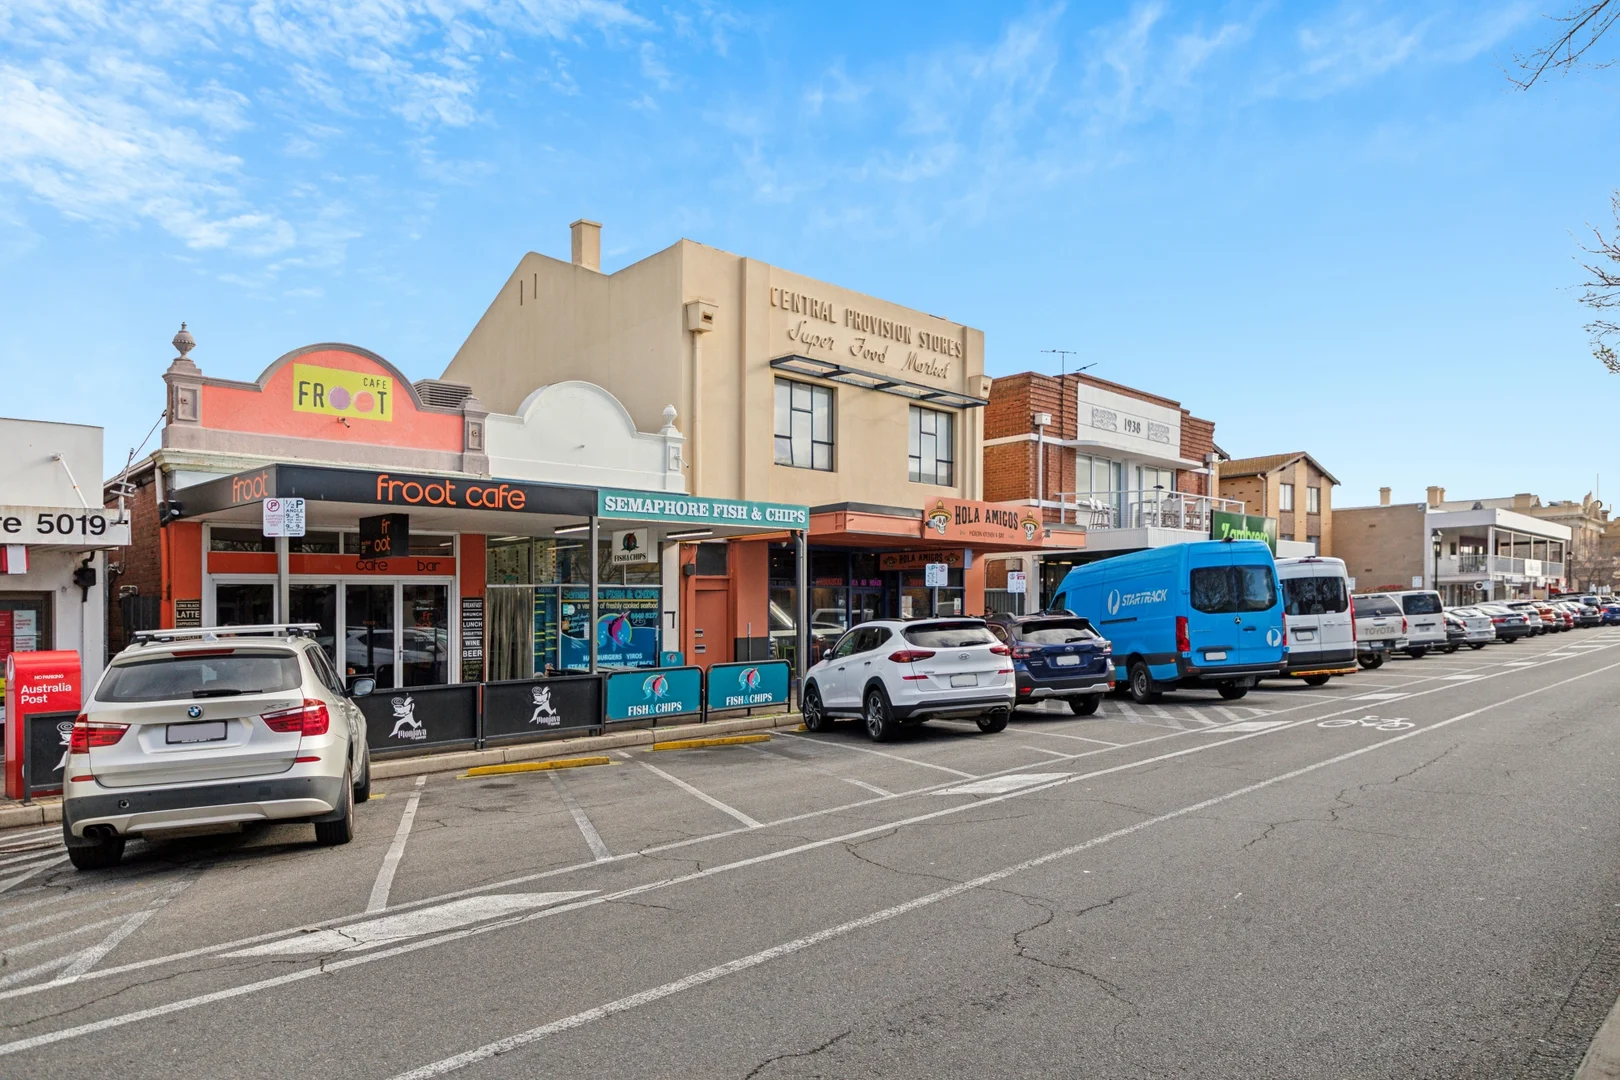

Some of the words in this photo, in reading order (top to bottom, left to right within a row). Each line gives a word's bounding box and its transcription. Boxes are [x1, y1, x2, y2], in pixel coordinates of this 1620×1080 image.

[770, 287, 836, 323] CENTRAL
[846, 308, 912, 344] PROVISION
[919, 330, 962, 358] STORES
[788, 320, 834, 354] Super
[850, 337, 888, 364] Food
[901, 351, 950, 379] Market
[363, 378, 386, 390] CAFE
[1124, 418, 1141, 434] 1938
[232, 471, 268, 503] froot
[376, 474, 456, 505] froot
[466, 484, 526, 510] cafe
[605, 496, 709, 517] SEMAPHORE
[712, 503, 748, 520] FISH
[751, 508, 762, 521] &
[766, 508, 806, 524] CHIPS
[954, 505, 980, 526] HOLA
[985, 509, 1018, 530] AMIGOS
[36, 514, 106, 536] 5019
[356, 560, 388, 571] cafe
[417, 560, 441, 571] bar
[1122, 589, 1168, 607] STARTRACK
[1364, 626, 1396, 635] TOYOTA
[21, 683, 72, 694] Australia
[21, 694, 48, 704] Post
